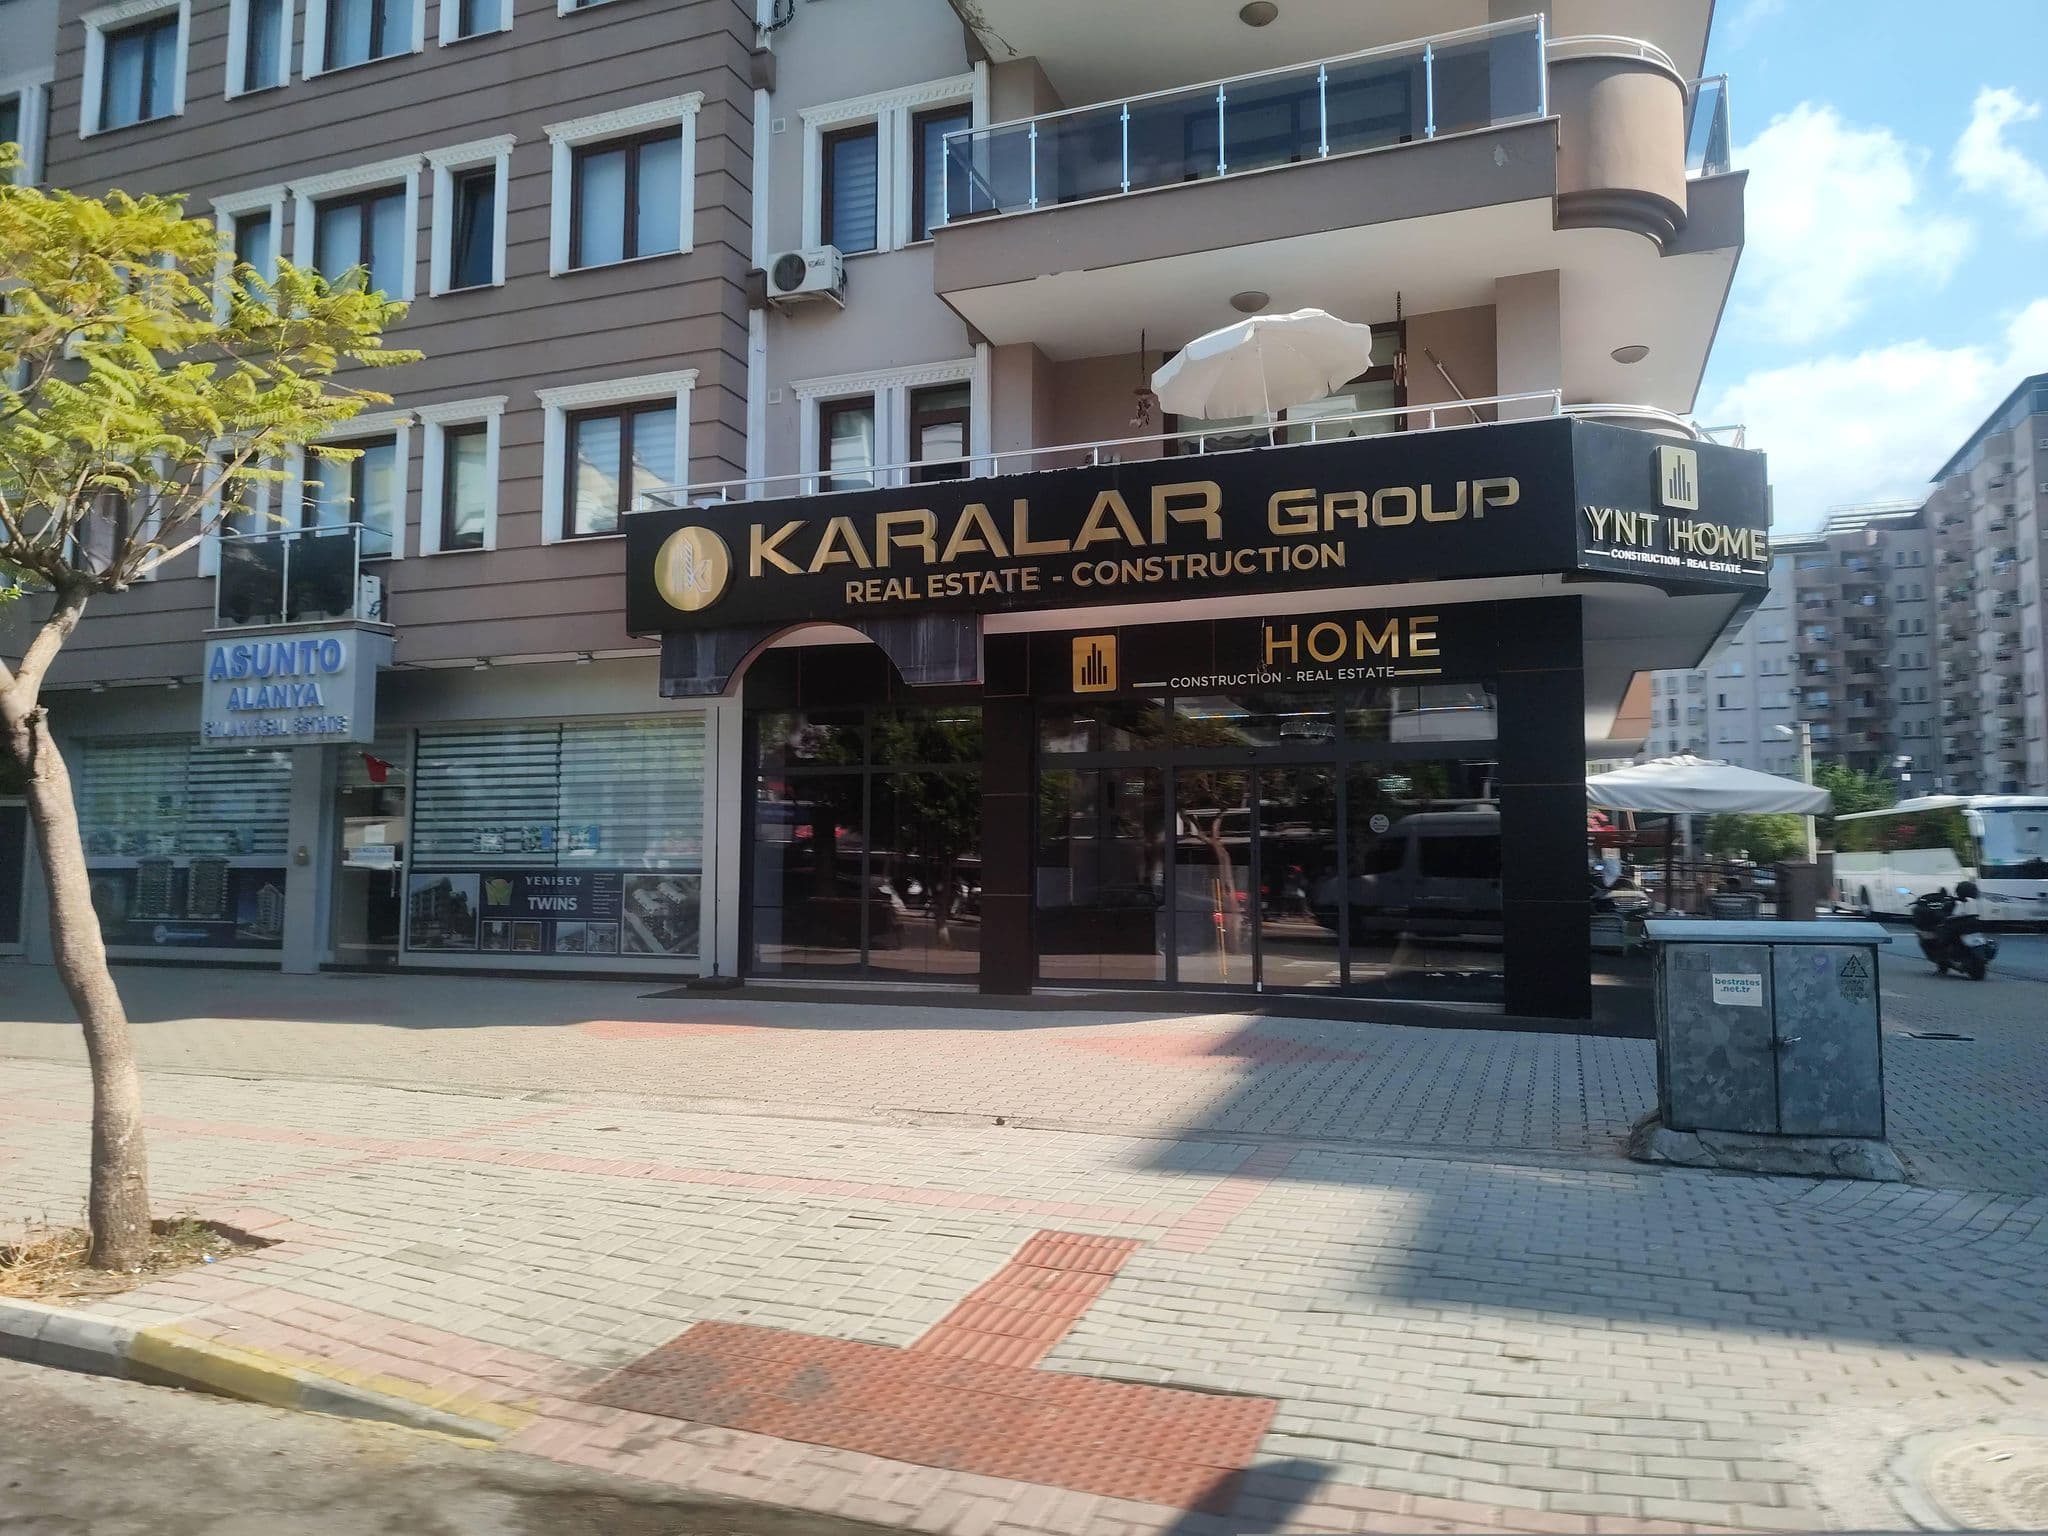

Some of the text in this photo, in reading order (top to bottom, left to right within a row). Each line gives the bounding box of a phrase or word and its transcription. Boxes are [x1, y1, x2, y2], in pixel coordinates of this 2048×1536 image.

[749, 480, 1223, 577] KARALAR
[1584, 506, 1768, 563] YNT HOME
[846, 577, 923, 604] REAL
[928, 566, 1041, 598] ESTATE
[1071, 541, 1346, 588] CONSTRUCTION
[1611, 549, 1680, 566] CONSTRUCTION
[1687, 558, 1709, 570] REAL
[1710, 560, 1741, 574] ESTATE
[1265, 615, 1441, 665] HOME
[208, 638, 344, 681] ASUNTO
[1170, 672, 1281, 689] CONSTRUCTION
[1297, 669, 1333, 682] REAL
[1337, 666, 1395, 680] ESTATE
[226, 683, 324, 710] ALANYA
[528, 896, 577, 910] TWINS
[1714, 978, 1760, 986] bestrates
